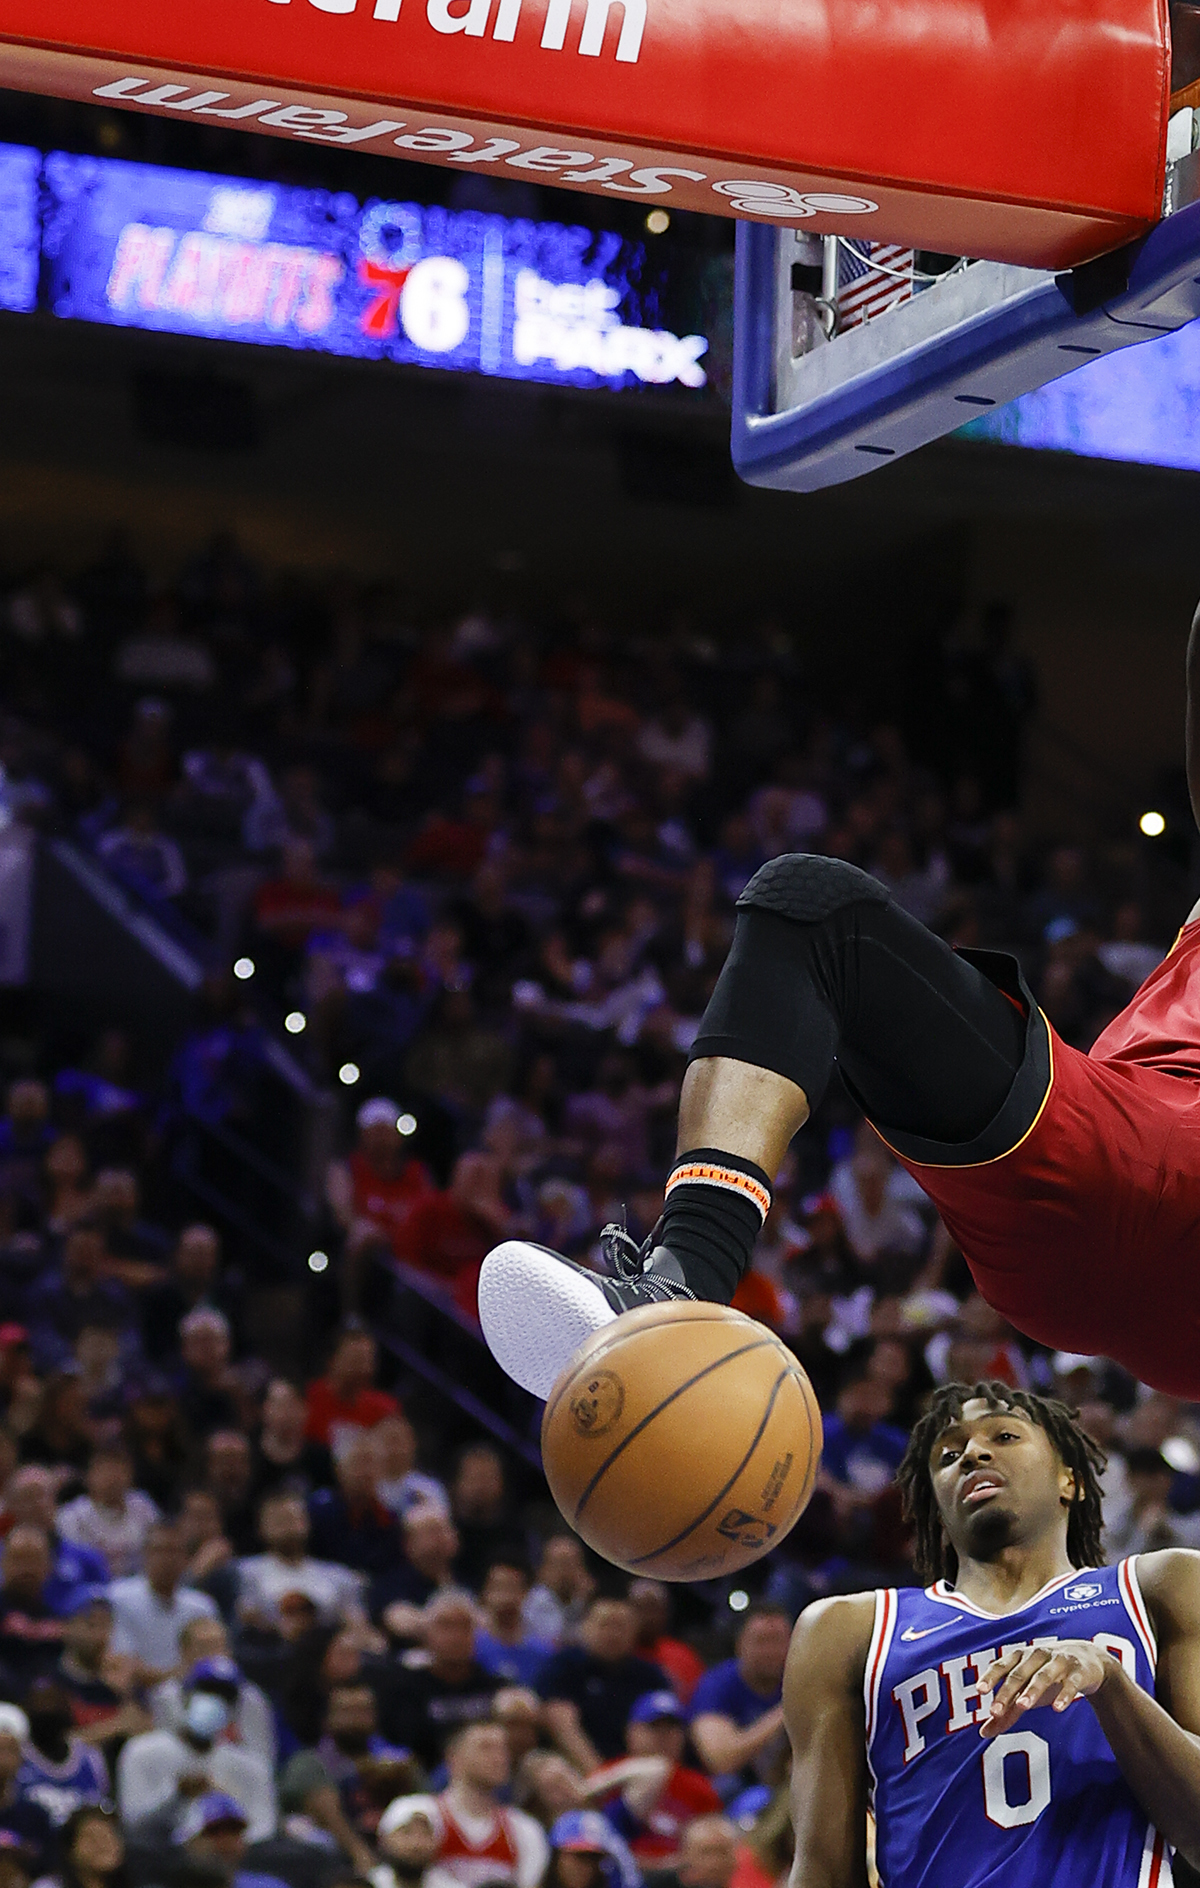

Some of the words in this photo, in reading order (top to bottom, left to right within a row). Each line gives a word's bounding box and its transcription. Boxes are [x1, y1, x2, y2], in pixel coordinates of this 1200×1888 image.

[92, 76, 708, 196] StateFarm
[1049, 1598, 1120, 1615] crypto.com
[981, 1730, 1052, 1831] 0
